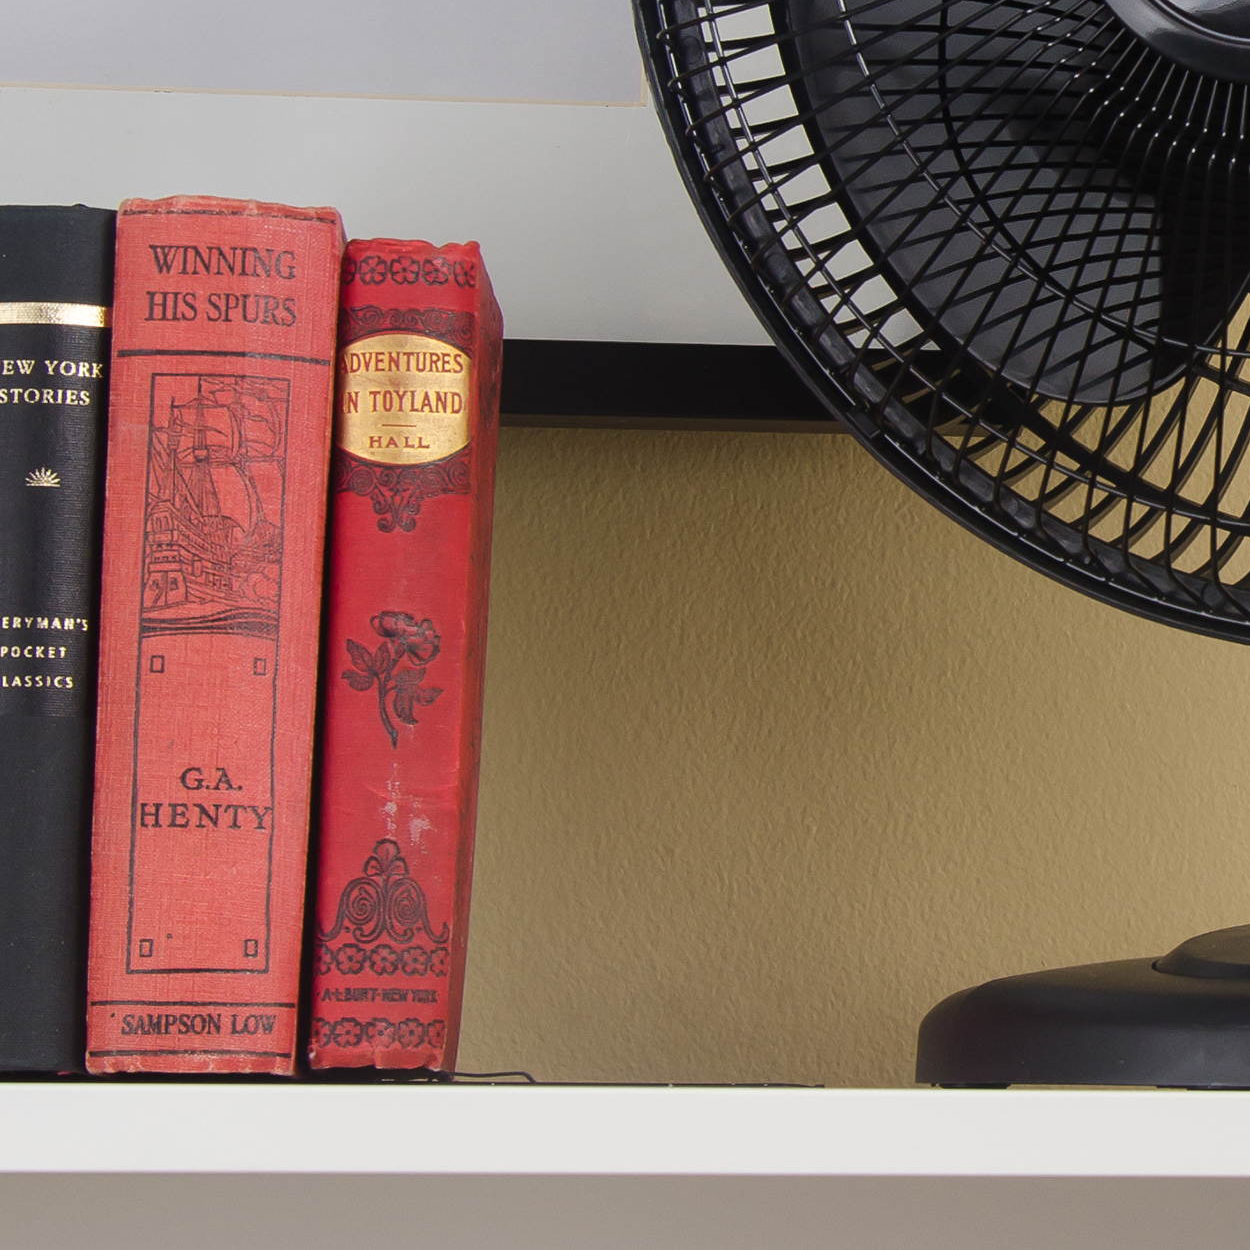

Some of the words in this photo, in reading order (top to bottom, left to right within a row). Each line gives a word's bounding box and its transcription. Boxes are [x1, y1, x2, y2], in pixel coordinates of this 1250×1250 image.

[149, 244, 296, 280] WINNING
[144, 290, 198, 322] HIS
[206, 293, 297, 327] SPURS
[44, 360, 104, 379] YORK
[0, 388, 91, 406] STORIES
[369, 389, 463, 415] TOYLAND
[368, 436, 431, 449] HALL
[0, 646, 67, 659] POCKET
[140, 803, 272, 830] HENTY
[121, 1013, 222, 1035] SAMPSON
[230, 1013, 277, 1035] LOW
